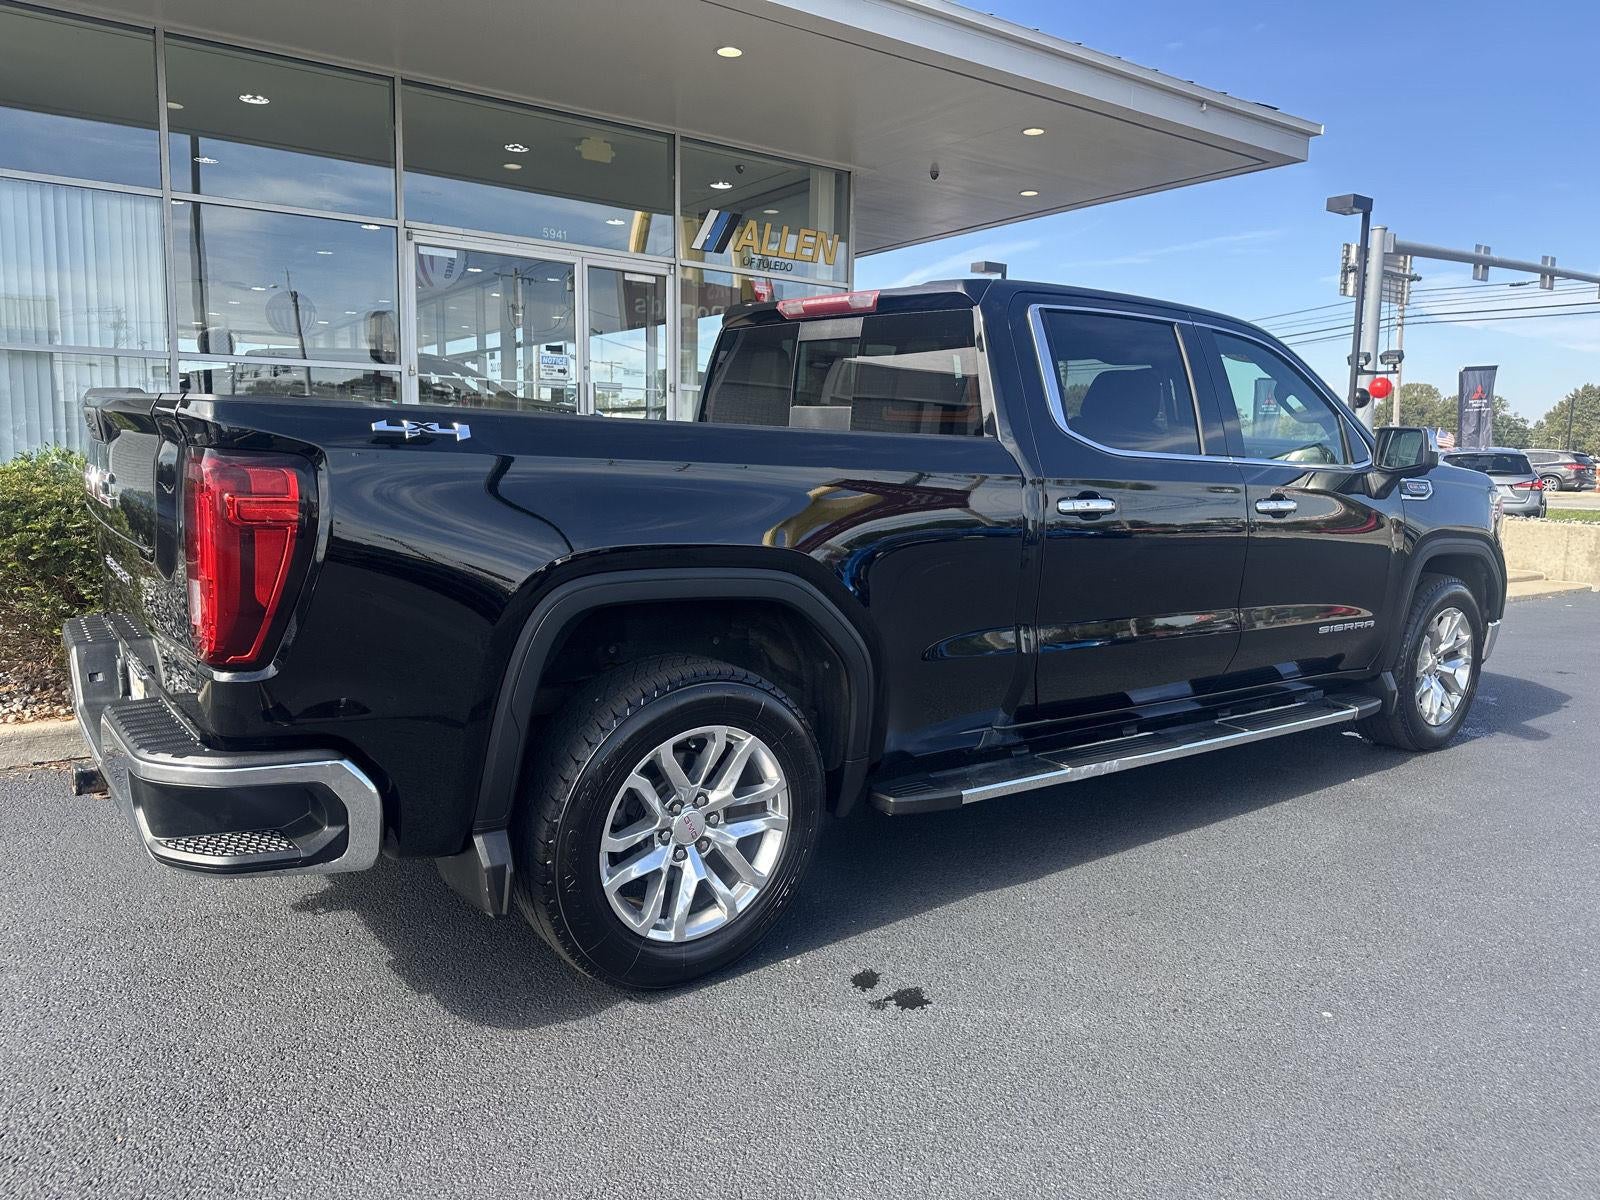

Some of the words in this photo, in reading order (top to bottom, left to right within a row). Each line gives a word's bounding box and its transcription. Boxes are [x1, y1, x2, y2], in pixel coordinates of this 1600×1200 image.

[543, 227, 568, 240] 5941
[734, 219, 839, 265] ALLEN
[743, 256, 757, 266] OF
[757, 257, 793, 272] TOLEDO
[542, 355, 567, 365] NOTICE
[1318, 620, 1375, 634] SIERRA
[683, 815, 698, 840] GMC
